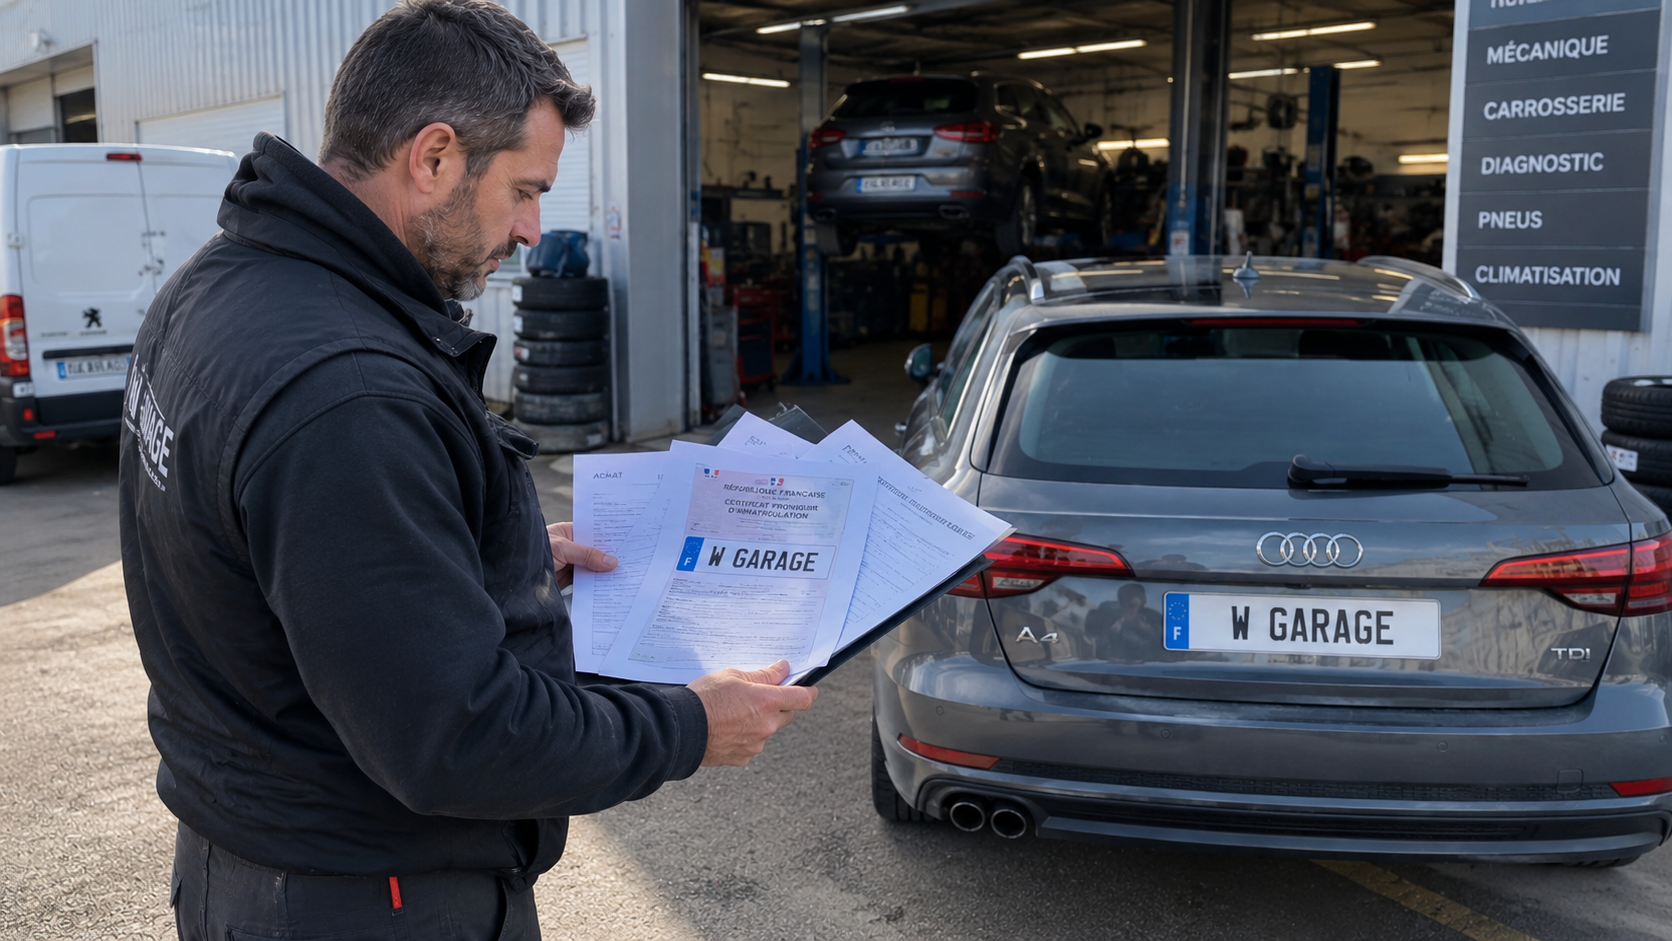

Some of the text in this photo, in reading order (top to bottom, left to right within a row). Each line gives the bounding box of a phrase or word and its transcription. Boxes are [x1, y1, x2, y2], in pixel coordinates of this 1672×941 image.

[1487, 35, 1609, 64] MÉCANIQUE
[1483, 93, 1626, 120] CARROSSERIE
[1481, 152, 1604, 175] DIAGNOSTIC
[1478, 211, 1543, 229] PNEUS
[1475, 265, 1621, 286] CLIMATISATION
[683, 546, 819, 572] F W GARAGE
[1015, 626, 1059, 644] A4
[1173, 606, 1394, 645] F W GARAGE
[1550, 647, 1591, 660] TDI
